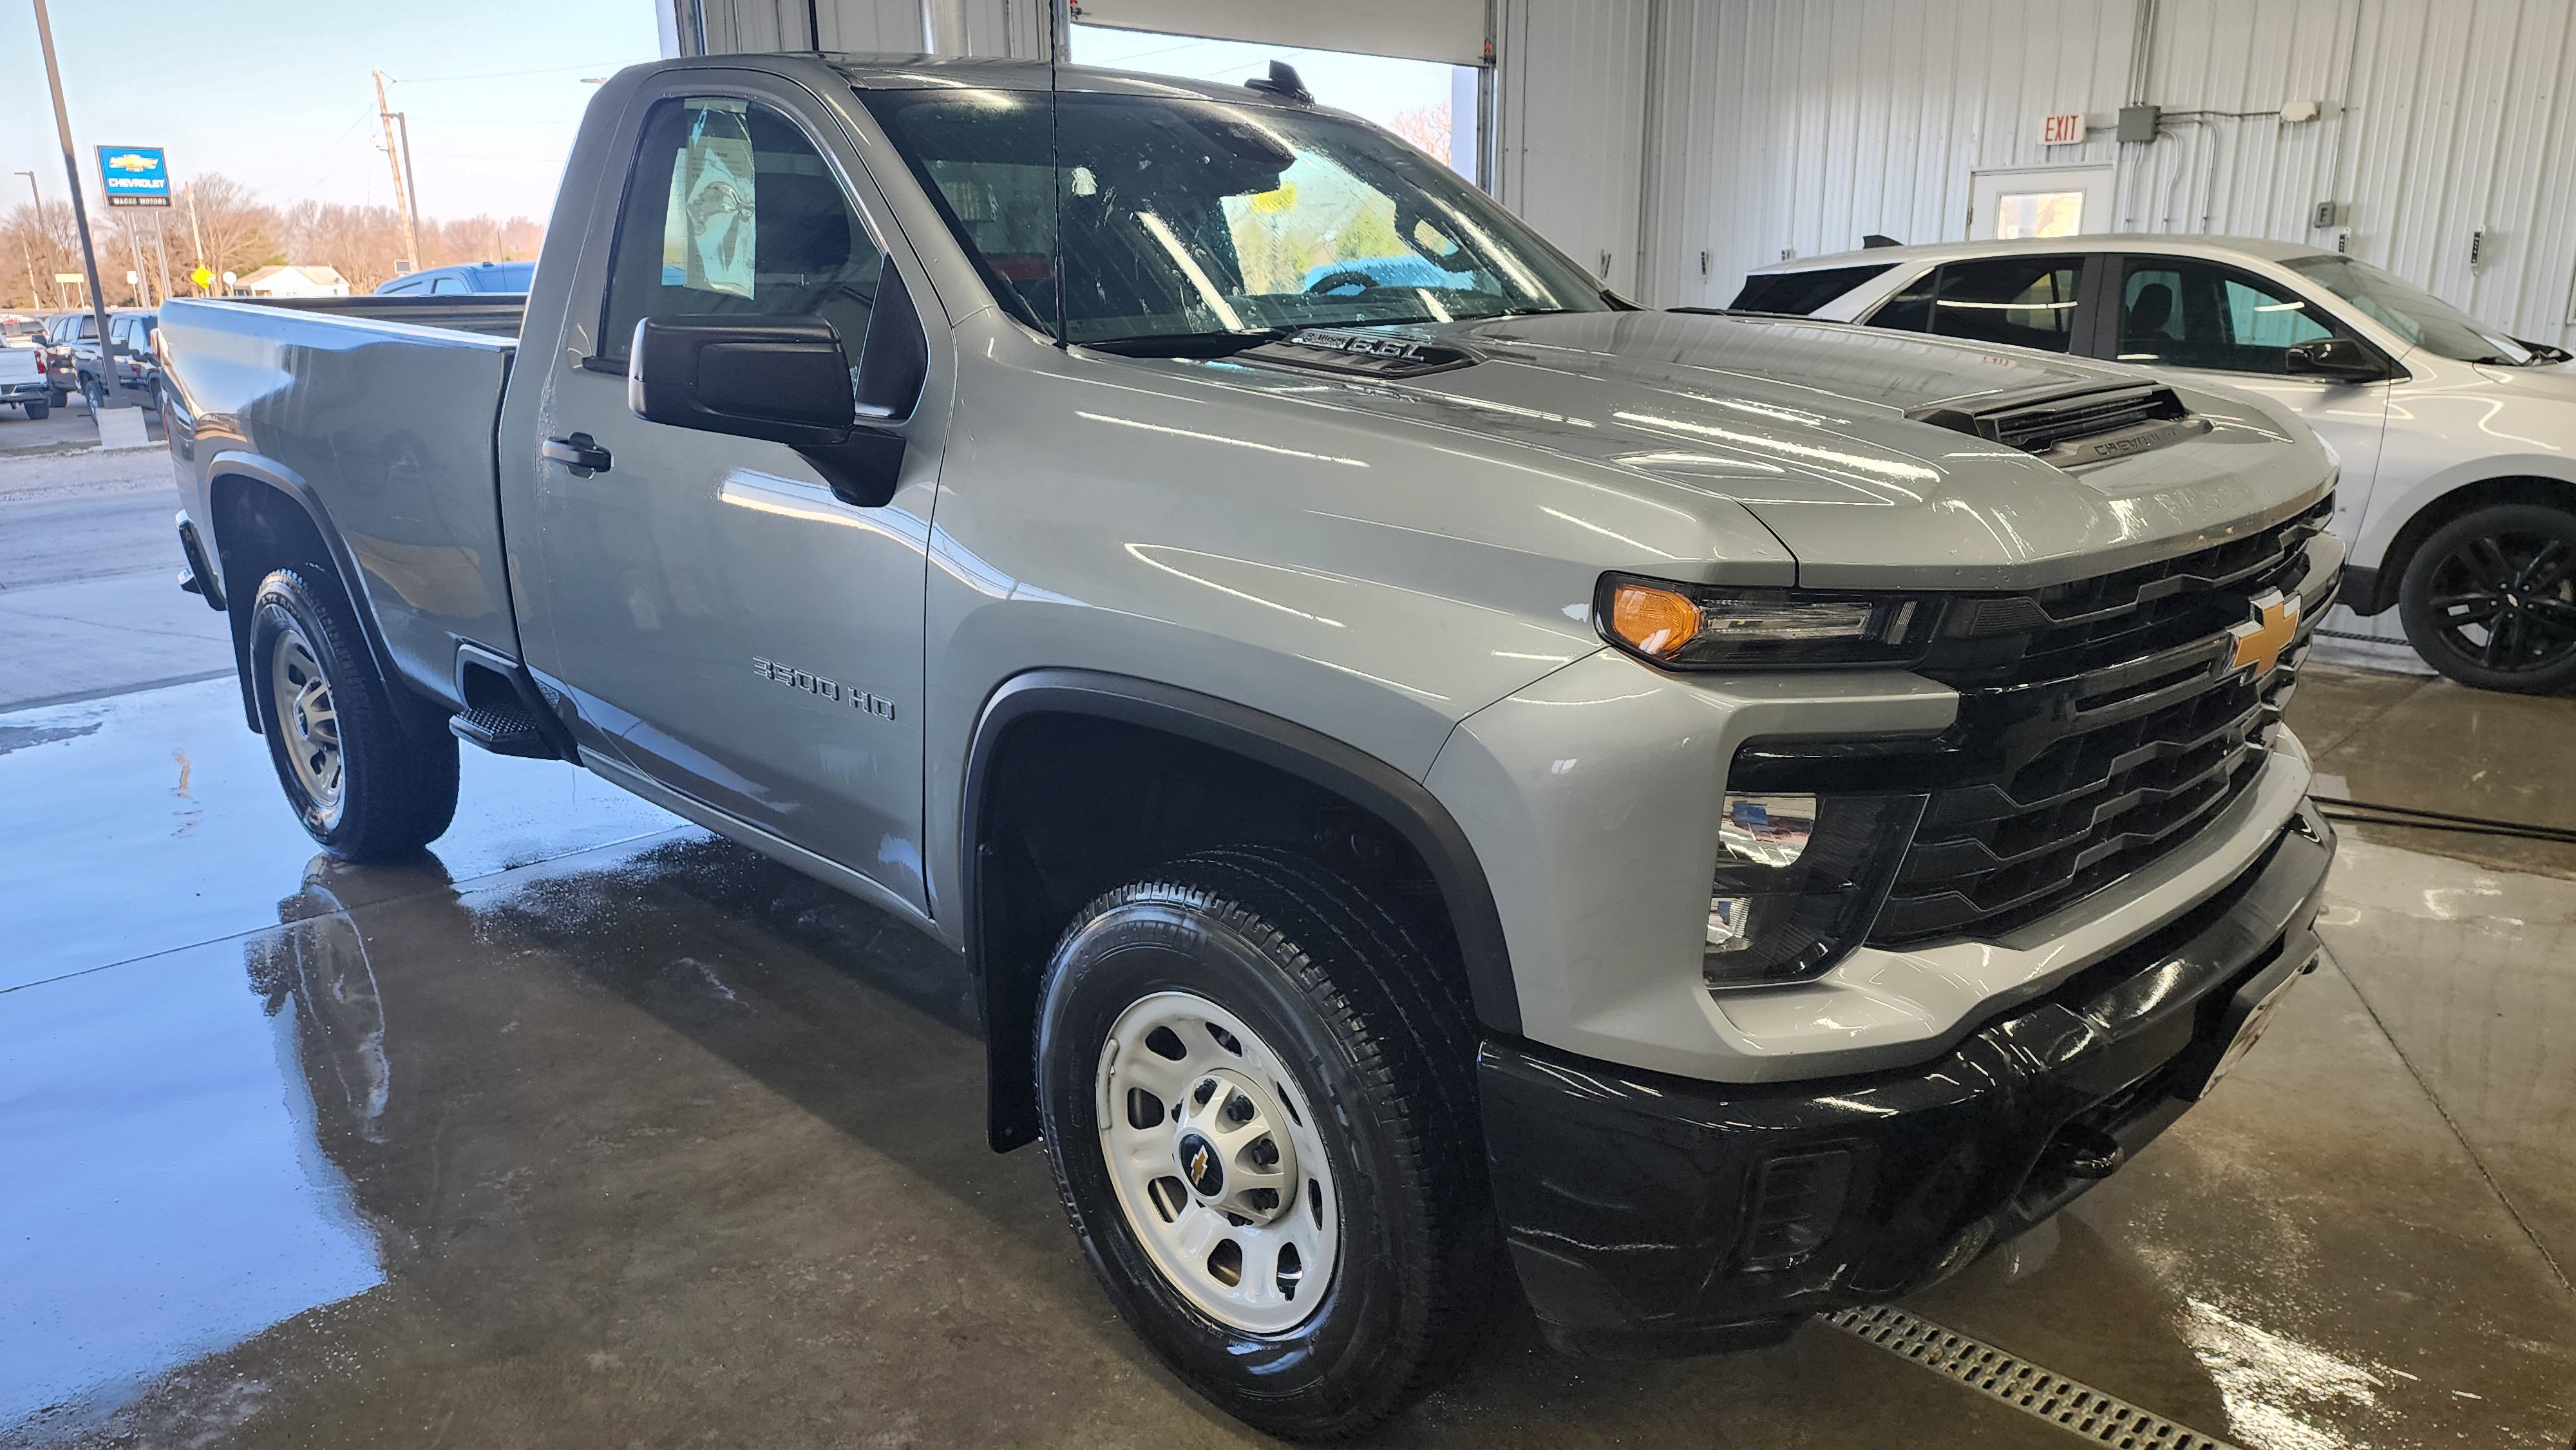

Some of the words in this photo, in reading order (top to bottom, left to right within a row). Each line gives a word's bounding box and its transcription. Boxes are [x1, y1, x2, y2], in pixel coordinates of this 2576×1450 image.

[2045, 115, 2078, 142] EXIT
[108, 178, 164, 188] CHEVROLET
[752, 655, 839, 702] 3500
[848, 686, 895, 720] HD
